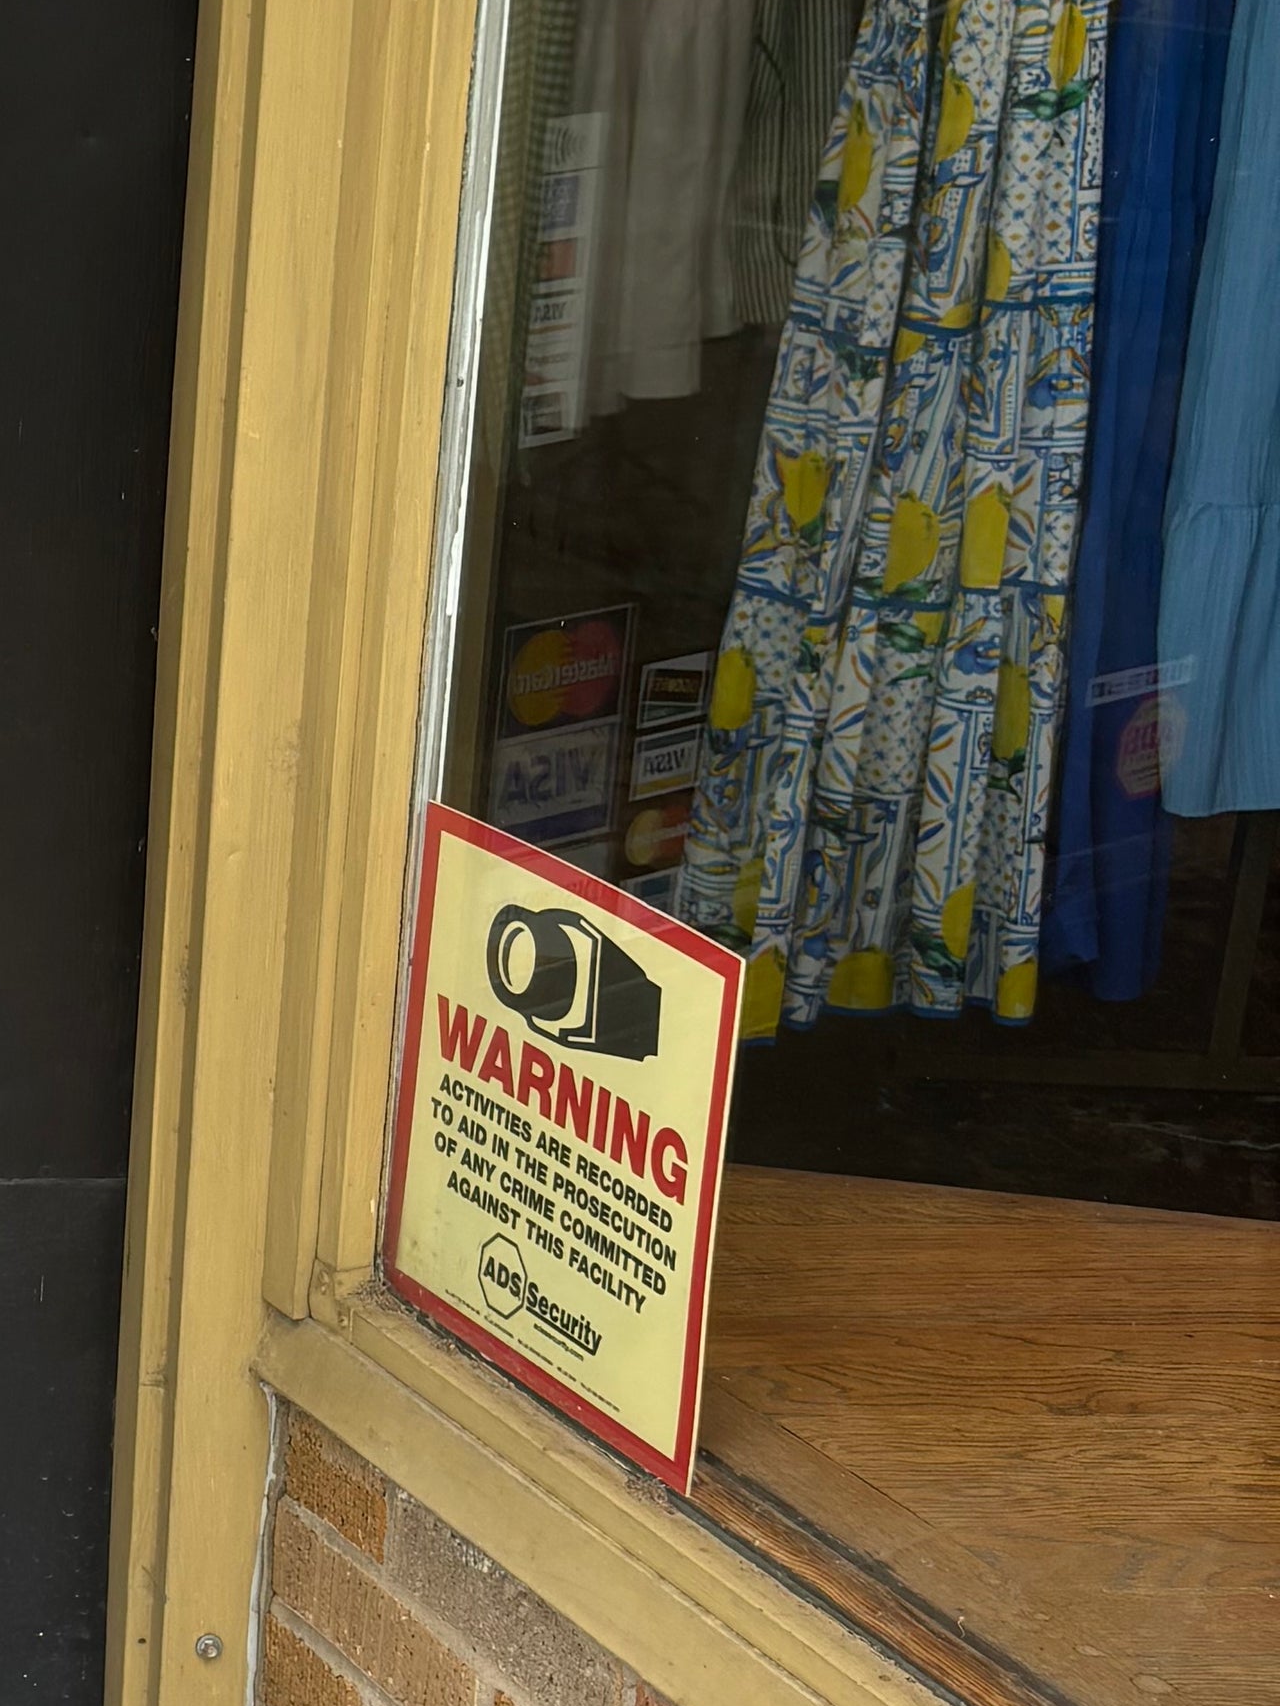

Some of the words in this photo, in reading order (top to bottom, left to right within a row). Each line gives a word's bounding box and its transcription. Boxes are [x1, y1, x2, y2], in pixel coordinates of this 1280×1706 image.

[437, 993, 689, 1206] WARNING
[439, 1073, 532, 1143] ACTIVITIES
[536, 1131, 572, 1169] ARE
[576, 1154, 673, 1233] RECORDED
[431, 1096, 454, 1126] TO
[457, 1115, 487, 1146] AID
[492, 1133, 510, 1161] IN
[515, 1147, 549, 1185] THE
[552, 1172, 677, 1272] PROSECUTION
[434, 1131, 458, 1158] OF
[460, 1148, 497, 1183] ANY
[499, 1171, 556, 1223] CRIME
[559, 1210, 667, 1296] COMMITTED
[447, 1170, 521, 1230] AGAINST
[526, 1217, 565, 1260] THIS
[568, 1246, 646, 1314] FACILITY
[482, 1255, 522, 1297] ADS
[526, 1281, 603, 1348] Security
